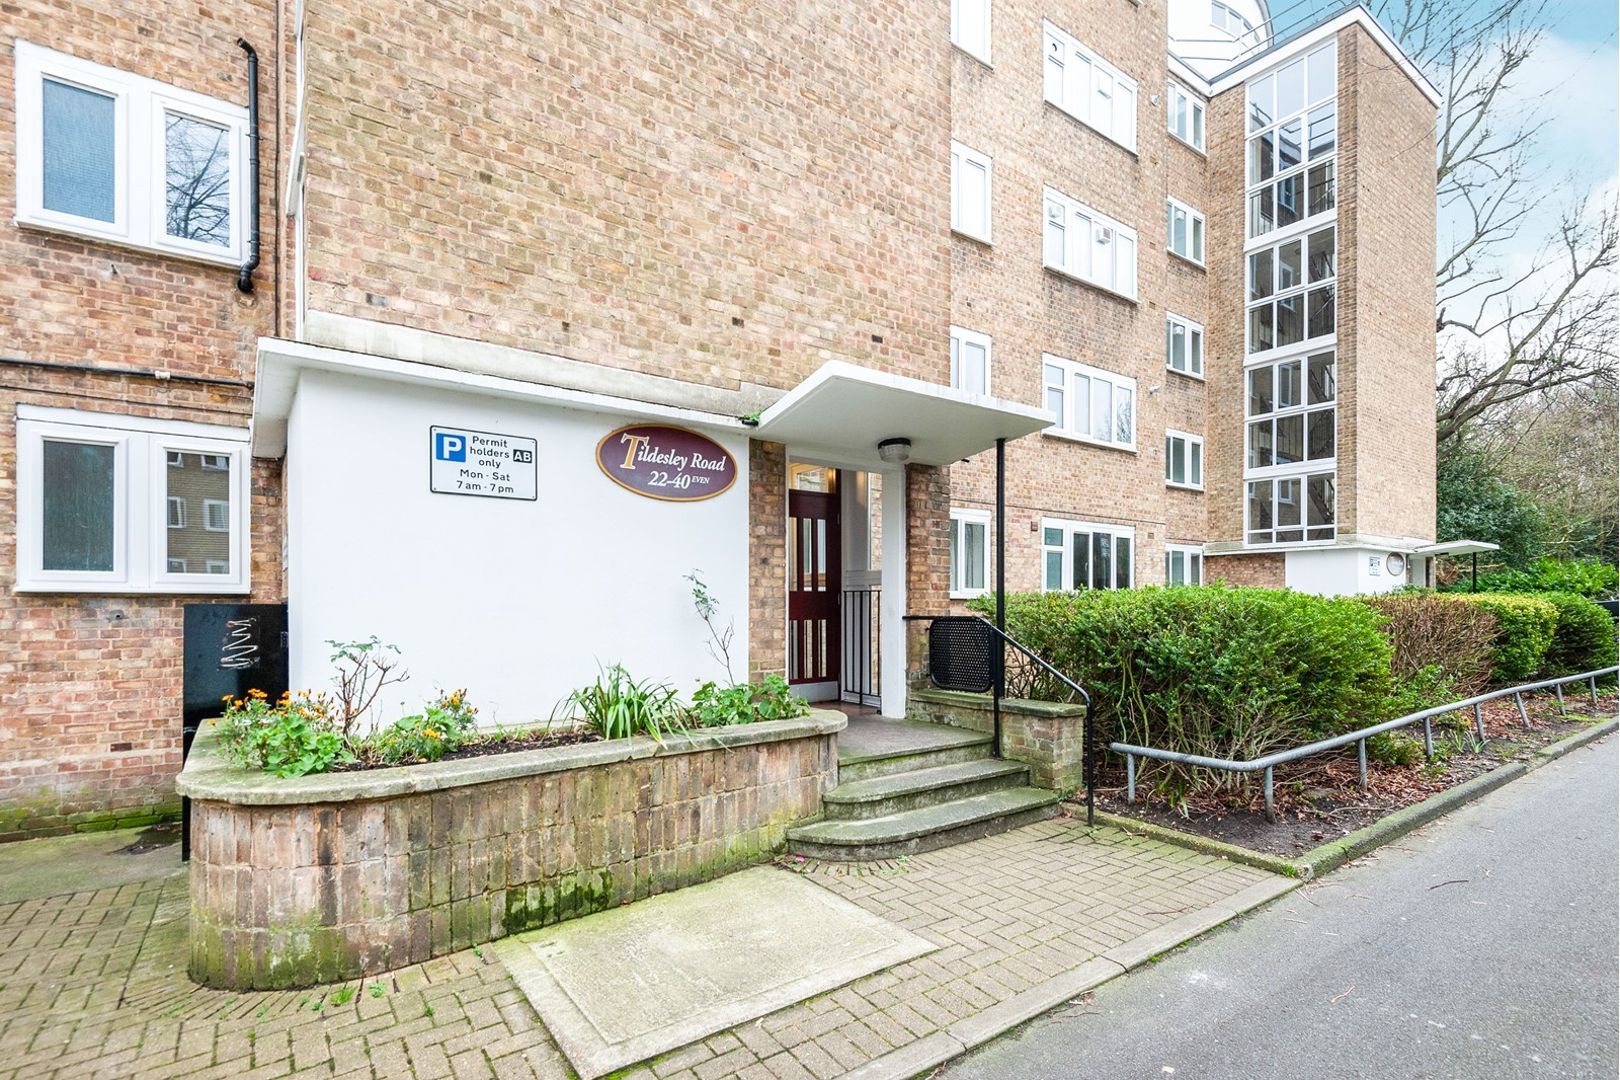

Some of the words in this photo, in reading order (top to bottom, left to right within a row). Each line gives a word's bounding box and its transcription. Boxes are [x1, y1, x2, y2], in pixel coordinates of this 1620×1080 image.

[443, 436, 462, 459] P
[472, 436, 508, 448] Permit
[470, 447, 510, 458] holders
[513, 450, 532, 462] AB
[619, 433, 688, 471] Tildesley
[690, 453, 727, 471] Road
[478, 459, 501, 469] only
[460, 469, 484, 479] Mon
[492, 472, 511, 482] Sat
[647, 471, 691, 489] 22-40
[691, 476, 711, 484] EVEN
